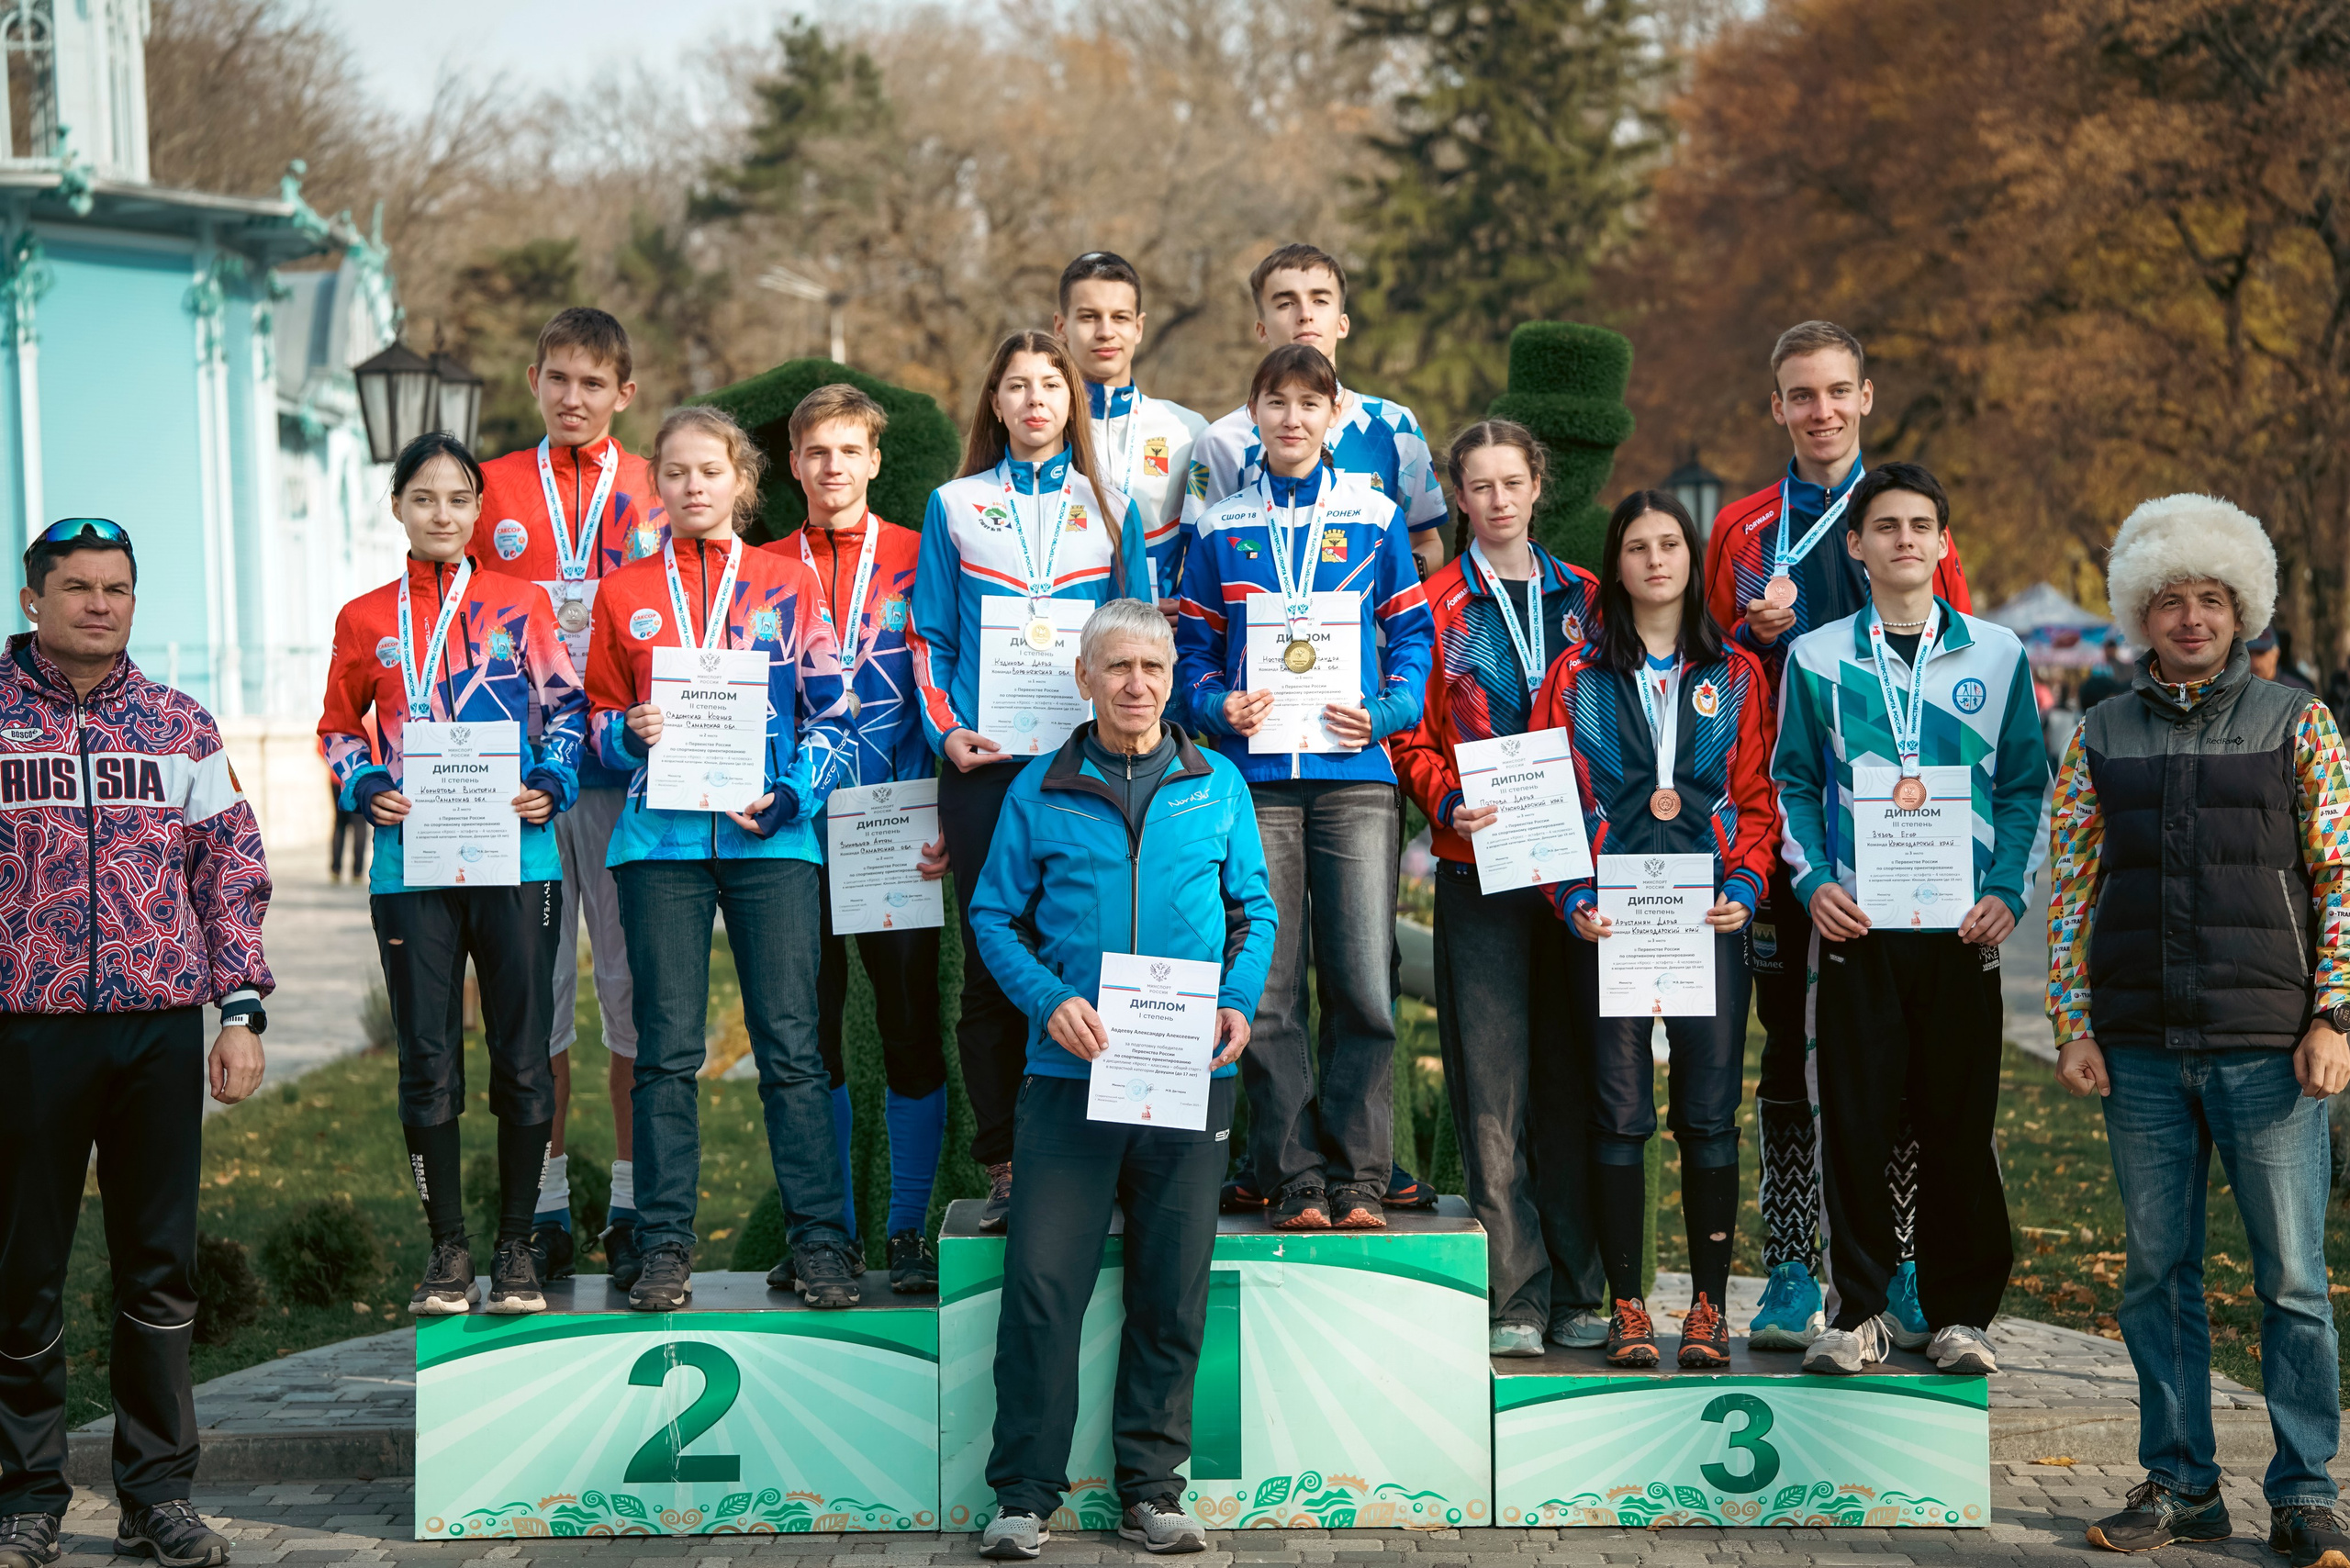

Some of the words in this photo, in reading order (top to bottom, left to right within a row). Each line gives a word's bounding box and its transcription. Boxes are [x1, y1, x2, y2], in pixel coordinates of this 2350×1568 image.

[1221, 512, 1246, 521] СШОР
[1326, 509, 1361, 518] РОНЕЖ
[1795, 531, 1819, 555] МИНИСТЕРСТВО
[1818, 517, 1830, 532] СПОРТА
[1829, 503, 1843, 518] РОССИИ
[1010, 498, 1023, 536] МИНИСТЕРСТВО
[1020, 534, 1028, 555] СПОРТА
[1025, 555, 1035, 578] РОССИИ
[1046, 539, 1058, 577] МИНИСТЕРСТВО
[1054, 519, 1062, 539] СПОРТА
[1058, 501, 1067, 519] РОССИИ
[1270, 518, 1282, 558] МИНИСТЕРСТВО
[1279, 556, 1287, 577] СПОРТА
[1283, 577, 1292, 599] РОССИИ
[423, 651, 436, 697] МИНИСТЕРСТВО
[432, 631, 443, 650] СПОРТА
[440, 609, 451, 631] РОССИИ
[408, 672, 416, 697] РОССИИ
[1875, 644, 1890, 688] МИНИСТЕРСТВО
[1886, 687, 1896, 710] СПОРТА
[1893, 710, 1903, 734] РОССИИ
[1911, 690, 1920, 734] МИНИСТЕРСТВО
[1919, 645, 1928, 666] РОССИИ
[681, 690, 737, 700] ДИПЛОМ
[11, 731, 33, 739] BOSCO
[432, 765, 488, 775] ДИПЛОМ
[1491, 771, 1545, 787] ДИПЛОМ
[1509, 785, 1539, 793] степень
[1885, 809, 1941, 818] ДИПЛОМ
[856, 816, 910, 830] ДИПЛОМ
[1628, 896, 1683, 906] ДИПЛОМ
[1130, 999, 1185, 1012] ДИПЛОМ
[1134, 1029, 1165, 1037] Александру
[1166, 1033, 1200, 1041] Алексеевичу
[623, 1340, 741, 1484] 2
[1700, 1393, 1781, 1495] 3
